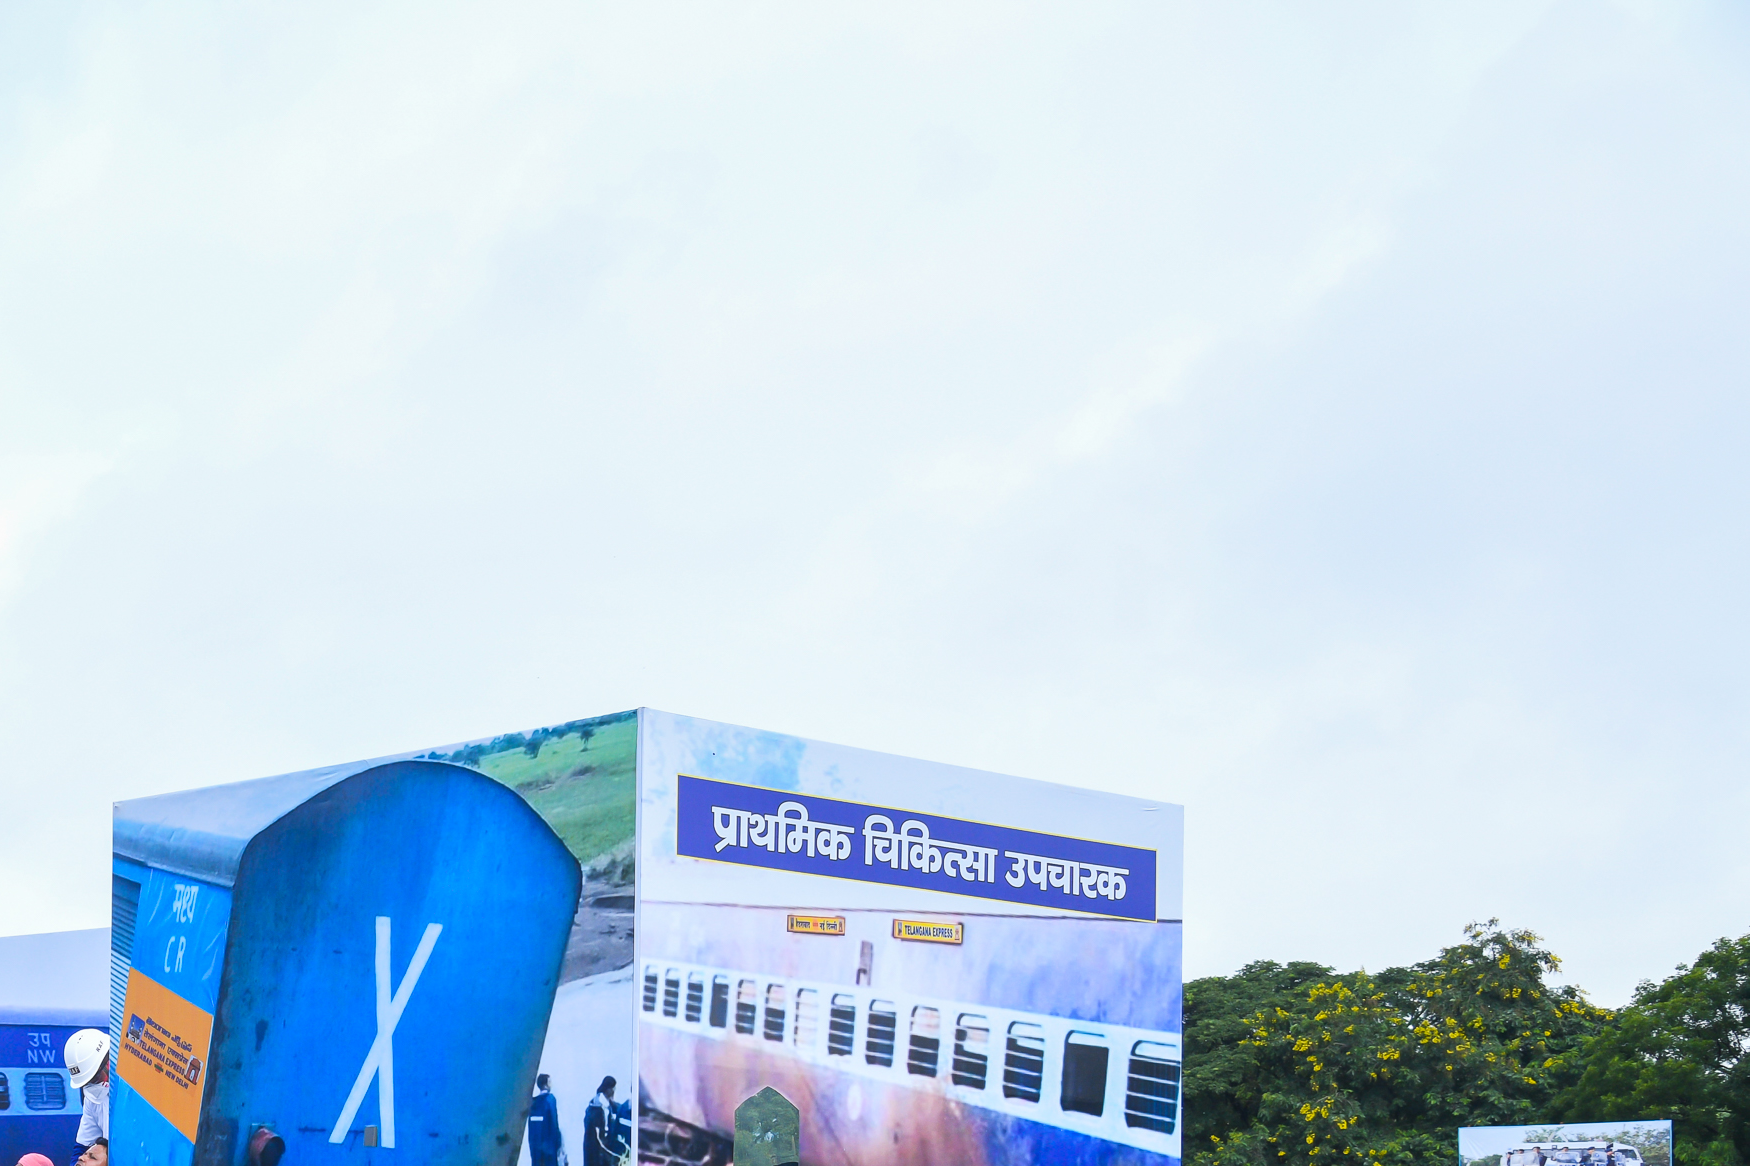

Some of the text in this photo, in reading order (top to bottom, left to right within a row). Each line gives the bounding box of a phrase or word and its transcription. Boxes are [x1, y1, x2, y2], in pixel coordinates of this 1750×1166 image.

[711, 800, 1130, 901] प्राथमिक चिकित्सा उपचारक
[904, 924, 953, 939] TELANGANA EXPRESS
[26, 1049, 56, 1064] NW
[123, 1042, 189, 1090] HYDERABAD NEW DELHI
[139, 1040, 185, 1076] TELANGANA EXPRESS
